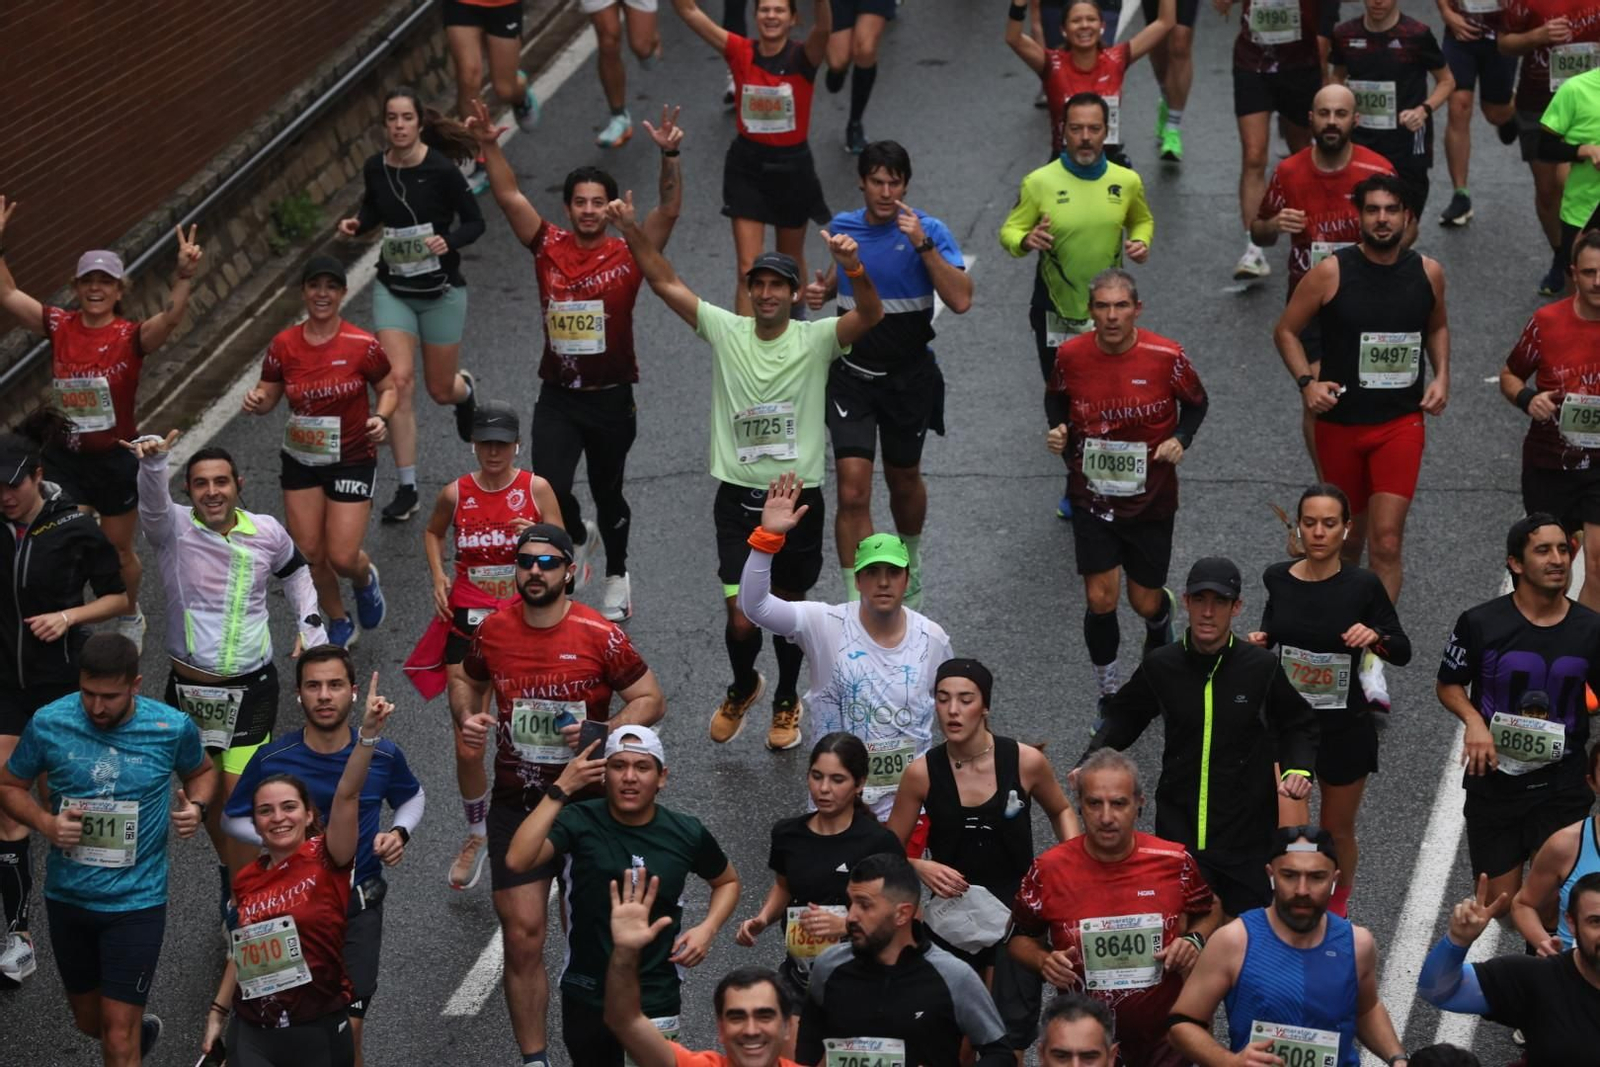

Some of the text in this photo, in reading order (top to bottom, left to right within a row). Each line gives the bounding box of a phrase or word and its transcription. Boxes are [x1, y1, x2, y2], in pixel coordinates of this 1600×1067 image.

[551, 314, 595, 331] 14762
[1370, 347, 1409, 364] 9497
[743, 418, 781, 437] 7725
[1088, 453, 1136, 472] 10389
[1291, 662, 1335, 685] 7226
[1501, 730, 1547, 755] 8685
[871, 753, 903, 775] 289
[240, 938, 282, 967] 7010
[1094, 933, 1146, 958] 8640
